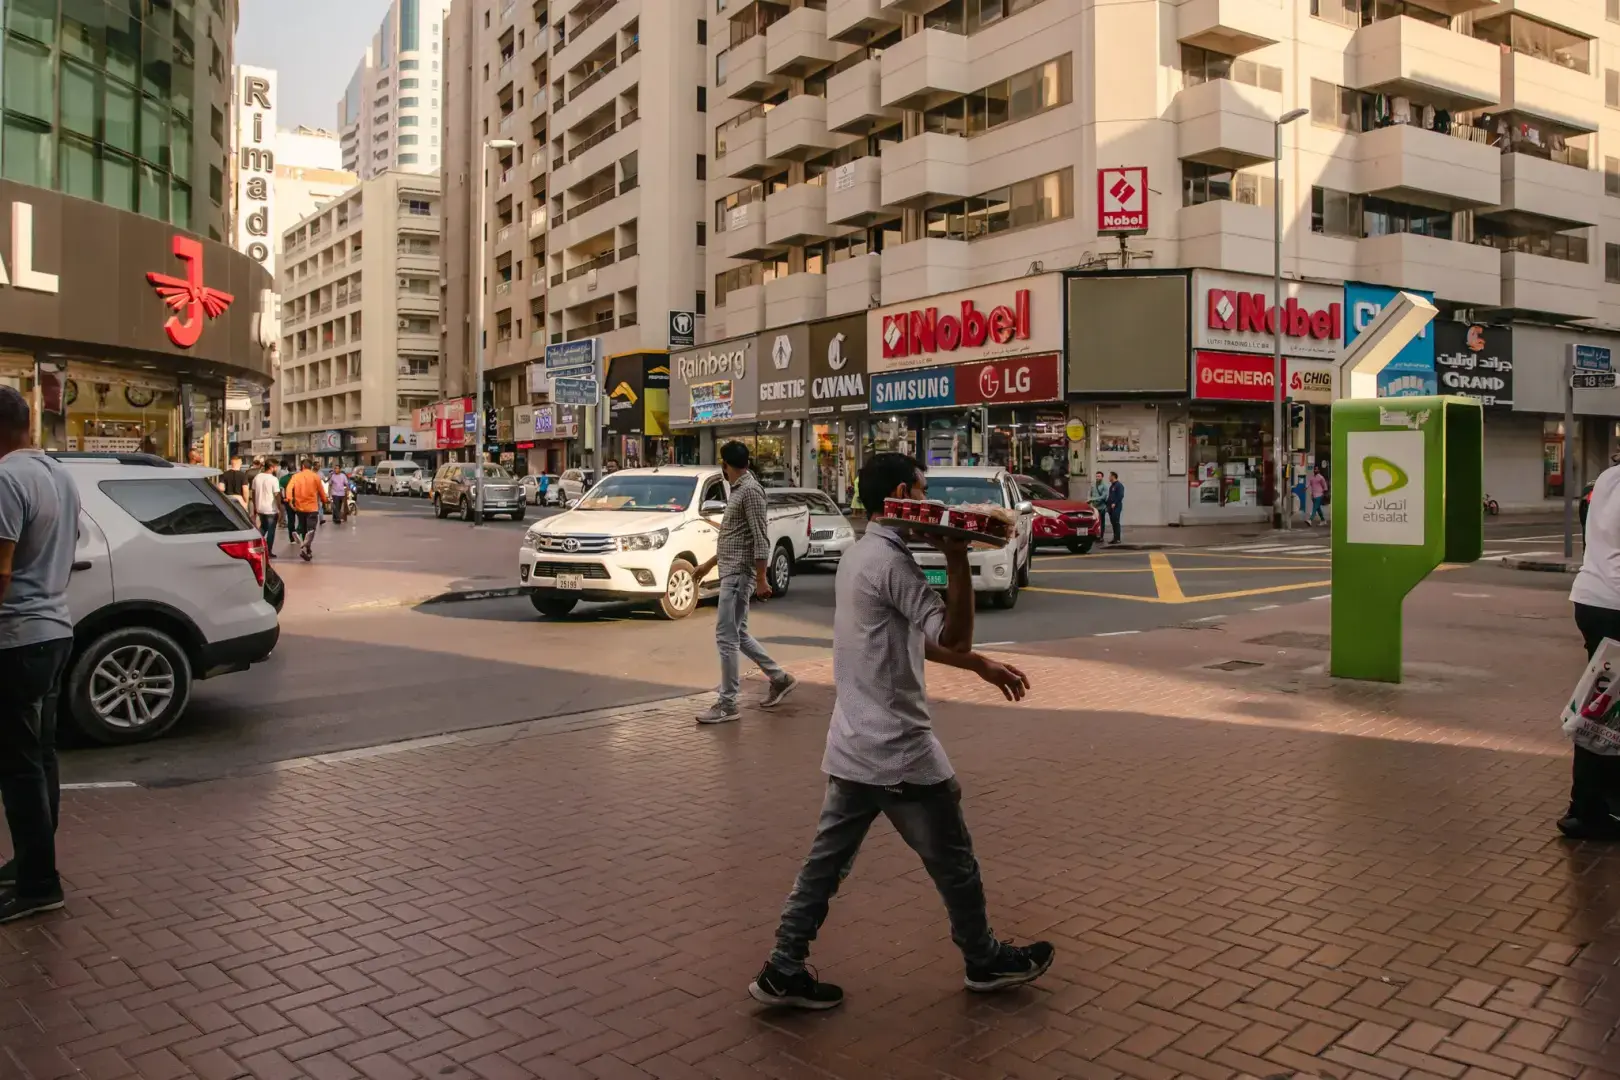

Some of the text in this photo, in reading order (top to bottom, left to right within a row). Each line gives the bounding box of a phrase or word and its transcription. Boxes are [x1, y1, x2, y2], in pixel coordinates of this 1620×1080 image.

[241, 75, 273, 264] Rimado
[1103, 214, 1143, 226] Nobel
[0, 200, 59, 294] L
[909, 289, 1031, 354] Nobel
[1237, 291, 1341, 340] Nobel
[677, 350, 746, 386] Rainberg
[1213, 368, 1283, 387] GENERA
[1303, 371, 1332, 385] CHIG
[760, 378, 805, 401] GENETIC
[811, 372, 865, 400] CAVANA
[875, 376, 949, 403] SAMSUNG
[1004, 366, 1031, 394] LG
[1442, 372, 1505, 391] GRAND
[1584, 376, 1596, 387] 18
[1363, 498, 1407, 511] اتصالات
[966, 520, 978, 528] TEA
[1362, 511, 1409, 523] etisalat
[1583, 720, 1620, 742] WELCOM
